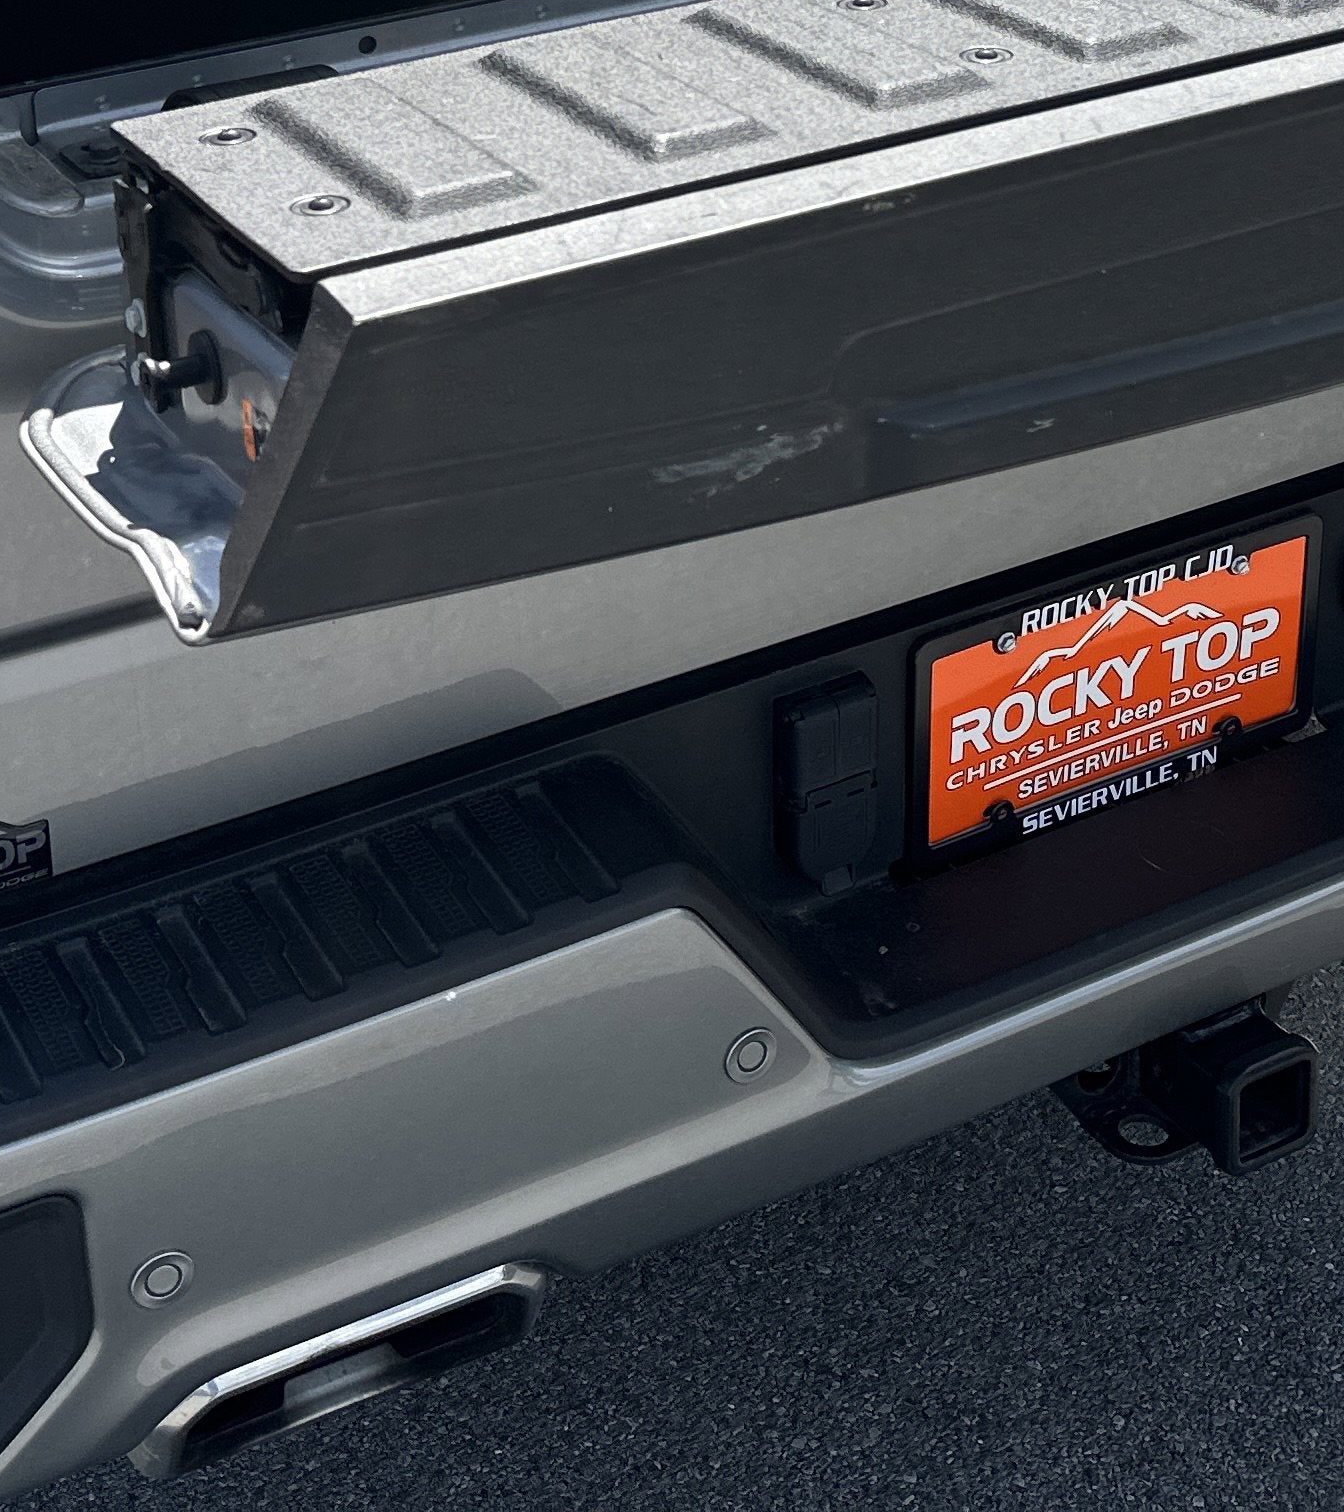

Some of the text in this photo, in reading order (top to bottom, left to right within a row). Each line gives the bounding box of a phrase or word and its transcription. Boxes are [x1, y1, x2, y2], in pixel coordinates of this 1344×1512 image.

[1021, 544, 1234, 637] ROCKY TOP CJD
[945, 657, 1280, 791] CHRYSLER Jeep DODGE
[949, 606, 1281, 764] ROCKY TOP
[1017, 715, 1207, 800] SEVIERVILLE, TN
[1022, 746, 1218, 835] SEVIERVILLE, TN
